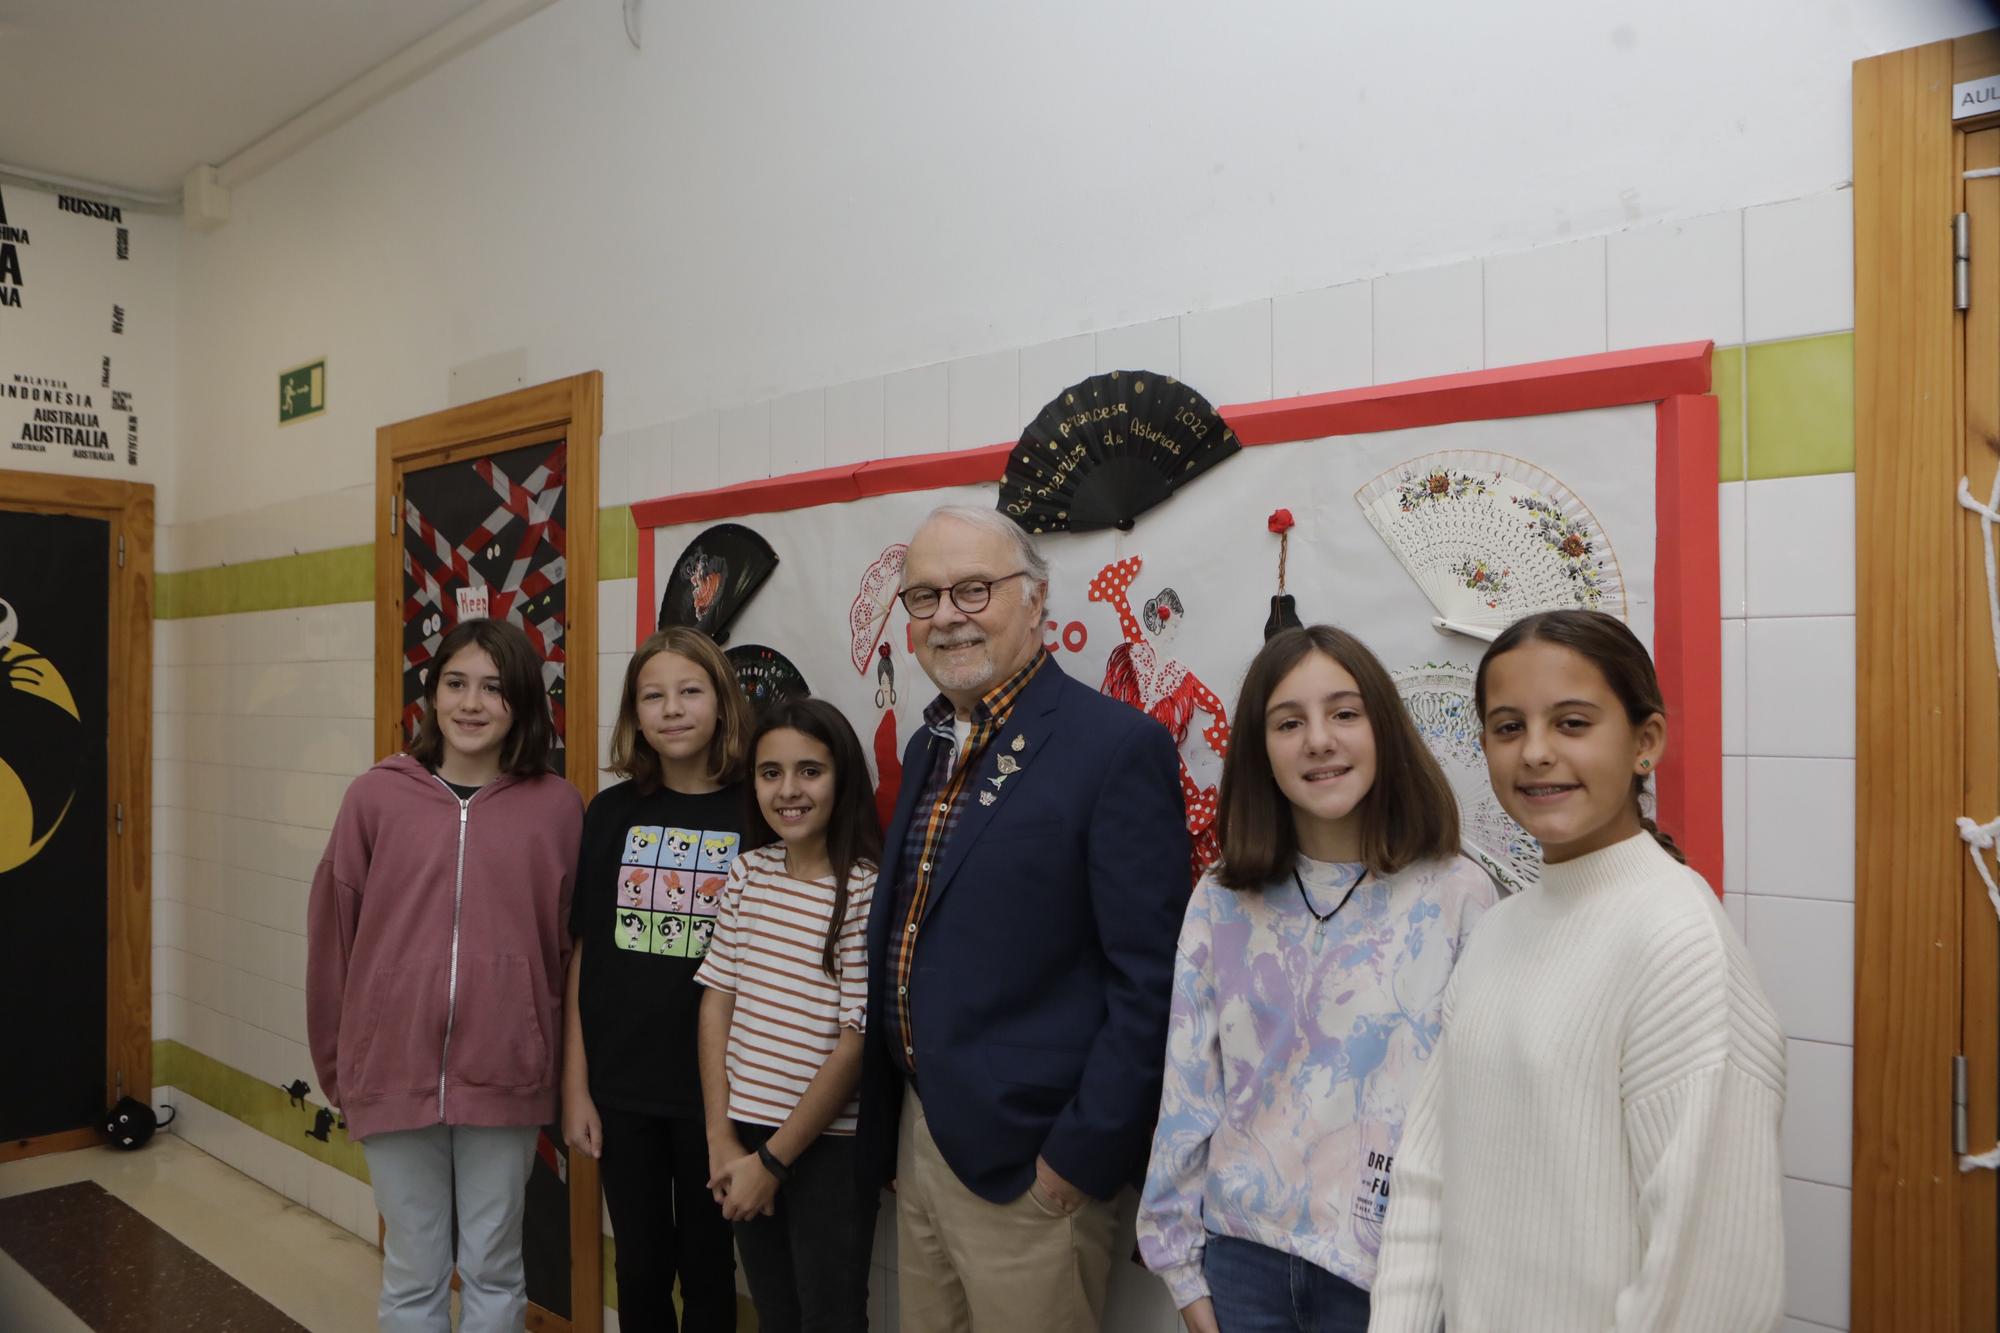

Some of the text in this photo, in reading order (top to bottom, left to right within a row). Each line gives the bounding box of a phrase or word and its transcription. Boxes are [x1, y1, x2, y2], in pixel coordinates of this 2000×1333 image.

[1961, 87, 2000, 107] AUL
[14, 374, 68, 389] MALAYSIA
[1, 383, 93, 408] INDONESIA
[34, 408, 99, 429] AUSTRALIA
[22, 423, 109, 449] AUSTRALIA
[1103, 425, 1124, 447] de
[1130, 416, 1183, 456] Asturias
[1174, 406, 1208, 440] 2022
[72, 449, 115, 462] AUSTRALIA
